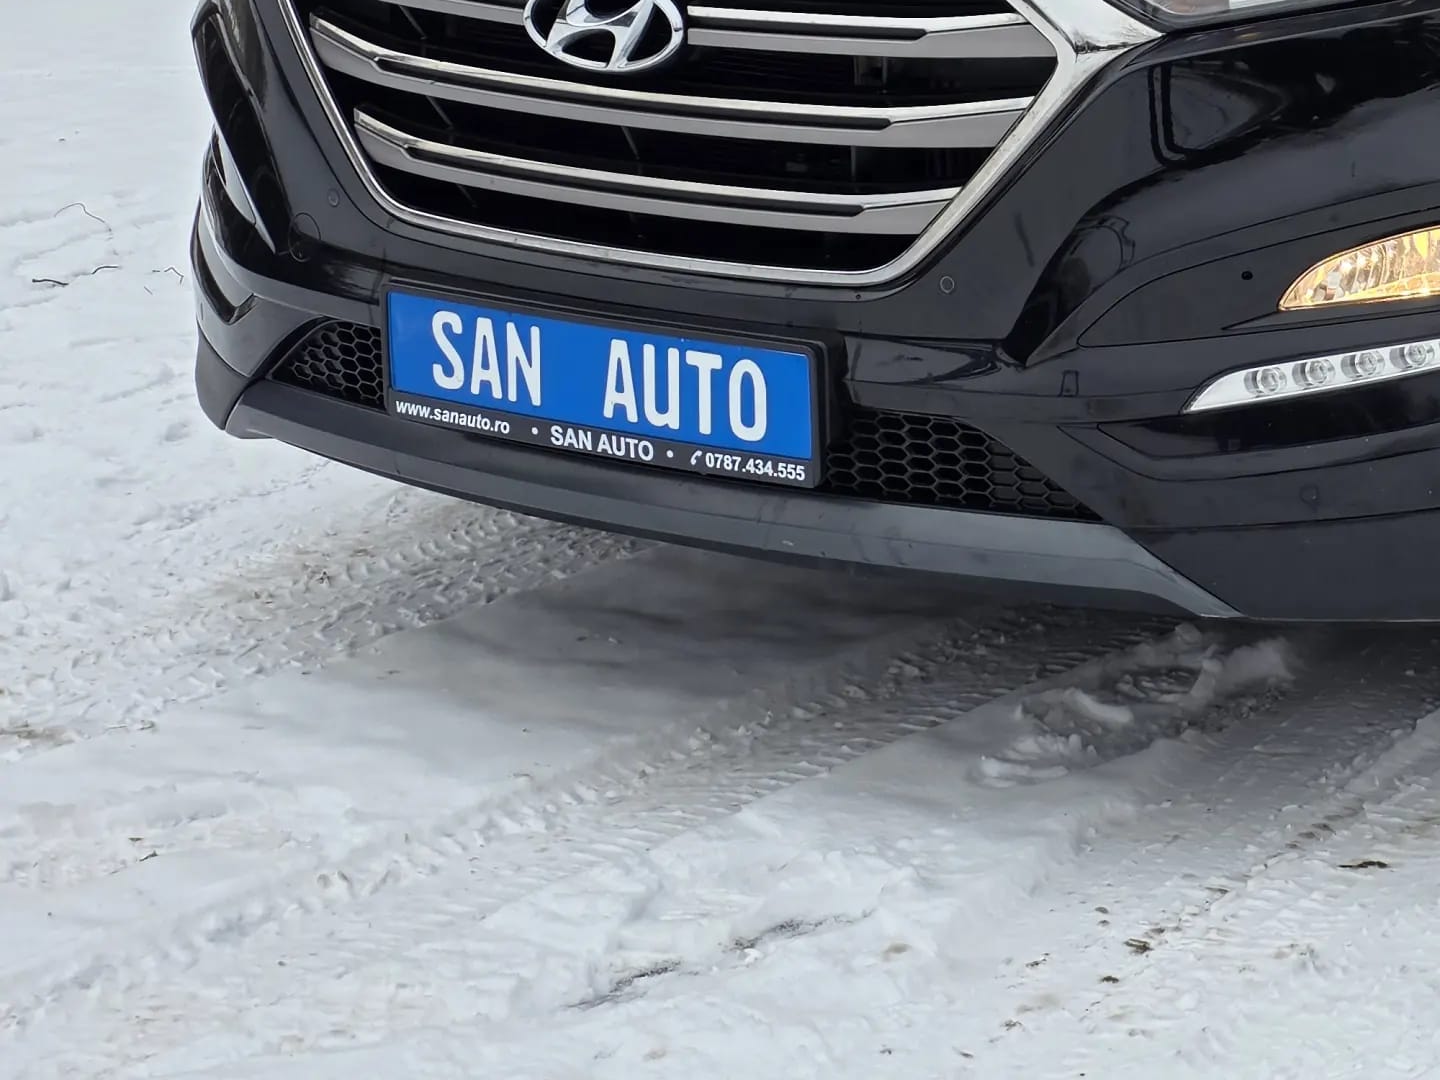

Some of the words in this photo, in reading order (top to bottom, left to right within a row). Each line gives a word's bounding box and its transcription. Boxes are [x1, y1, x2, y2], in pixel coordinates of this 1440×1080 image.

[432, 310, 541, 406] SAN
[603, 338, 767, 442] AUTO
[395, 400, 510, 434] www.sanauto.ro
[550, 425, 592, 451] SAN
[597, 433, 654, 462] AUTO
[705, 452, 806, 481] 0787.434.555
